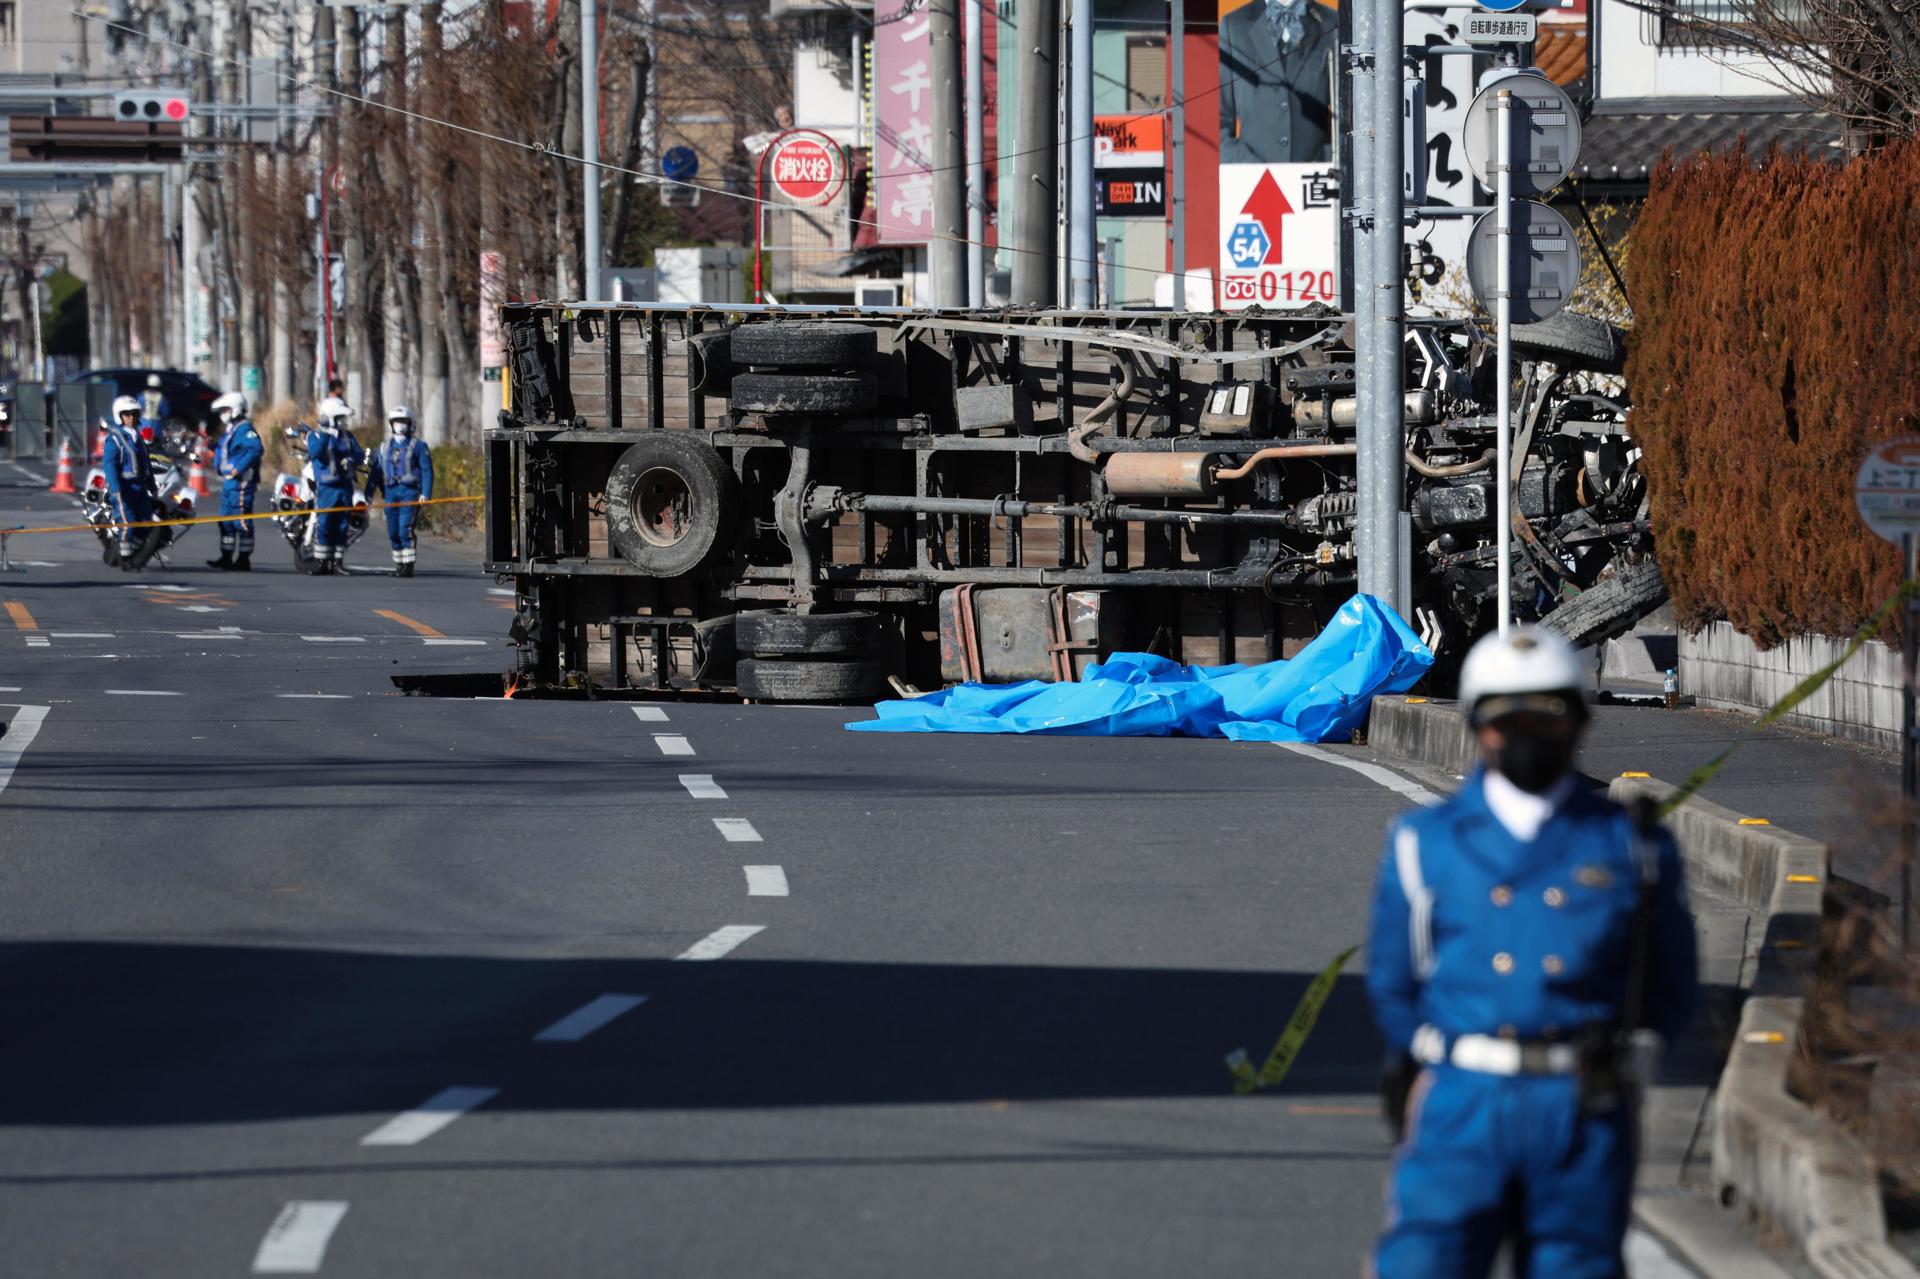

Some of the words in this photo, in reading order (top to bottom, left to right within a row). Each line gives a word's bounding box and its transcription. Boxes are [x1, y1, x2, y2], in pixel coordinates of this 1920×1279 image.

[1470, 20, 1528, 36] 自転車歩道通行可
[889, 0, 932, 226] ン千成亭
[1095, 121, 1127, 137] Navi
[778, 156, 829, 182] 消火栓
[1134, 182, 1161, 203] IN
[1232, 237, 1262, 263] 54
[1259, 270, 1334, 302] 0120
